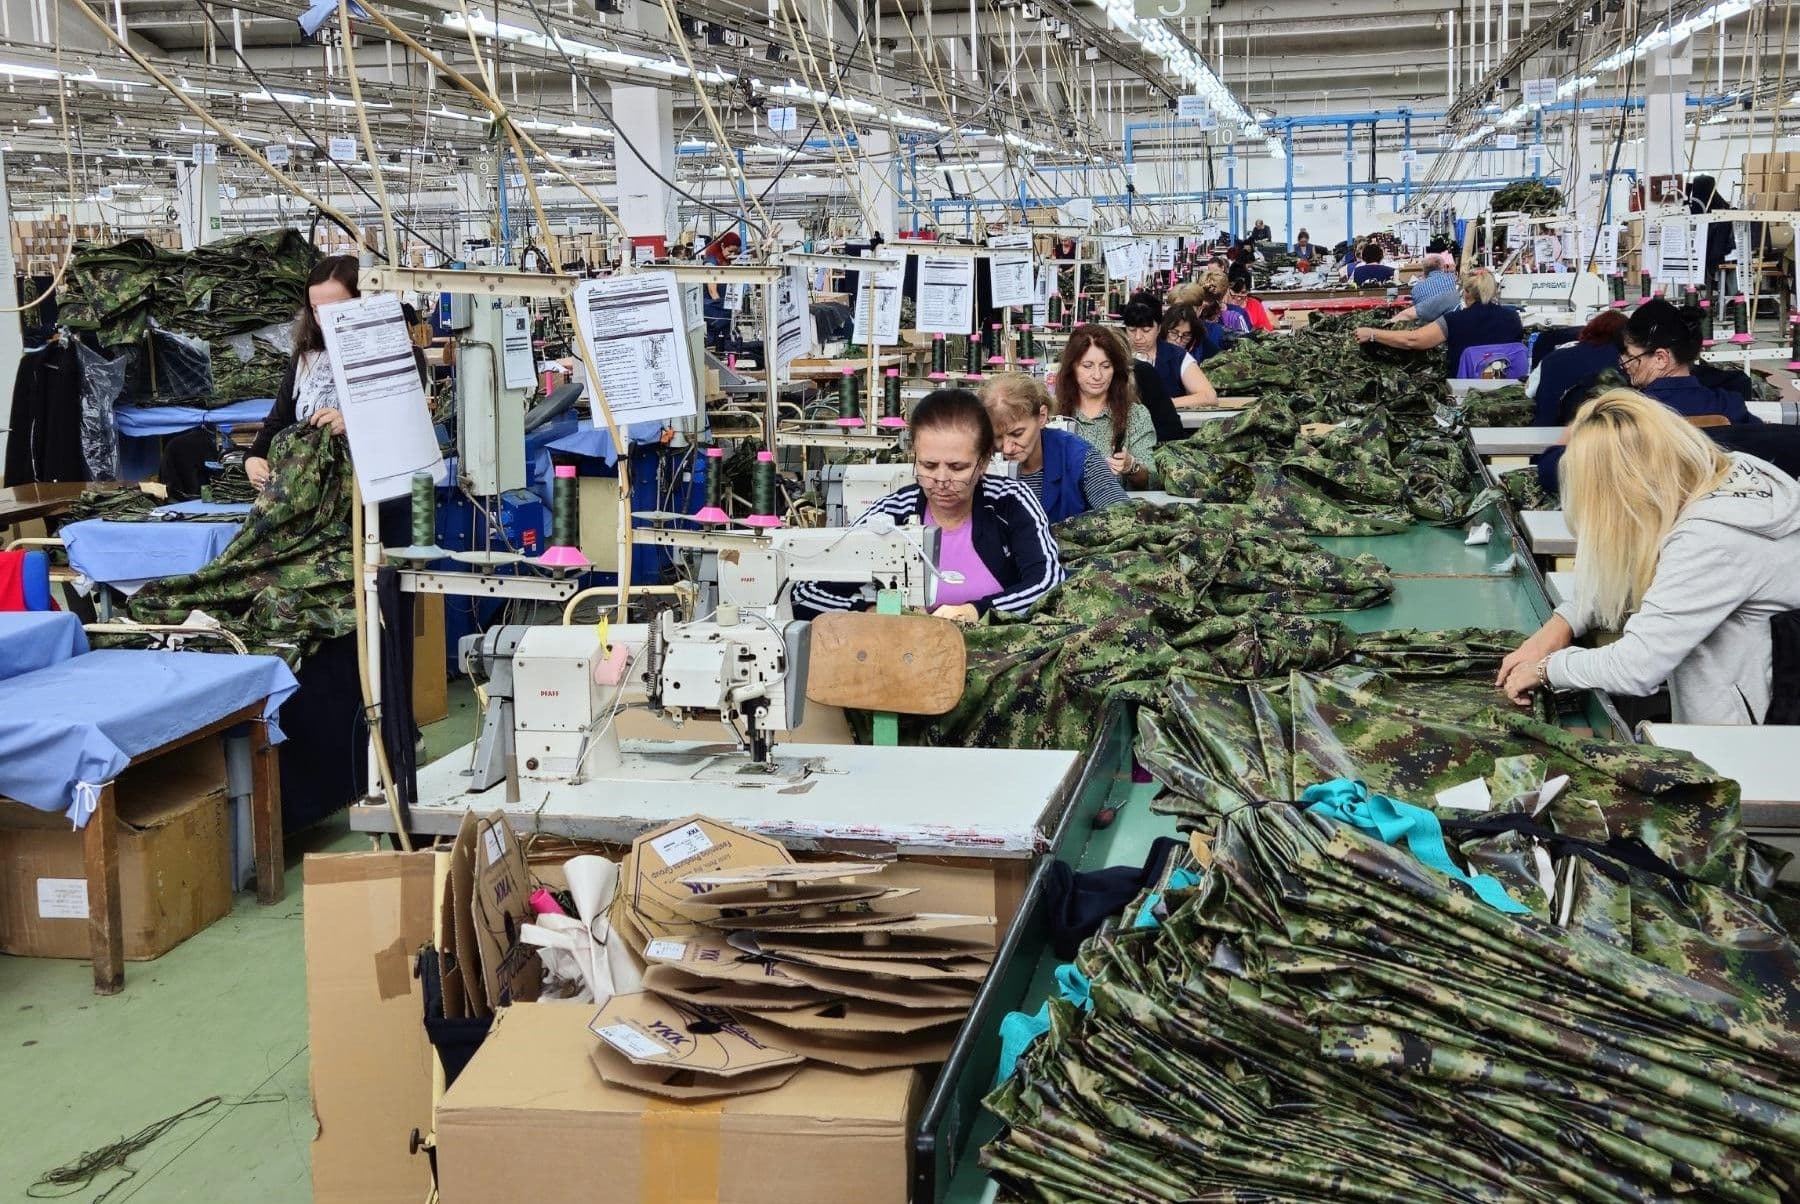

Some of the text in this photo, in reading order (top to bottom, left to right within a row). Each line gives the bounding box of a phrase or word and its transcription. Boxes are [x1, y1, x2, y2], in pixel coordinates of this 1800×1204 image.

[1212, 129, 1233, 144] 10
[479, 162, 489, 175] 9
[648, 1020, 691, 1046] YKK
